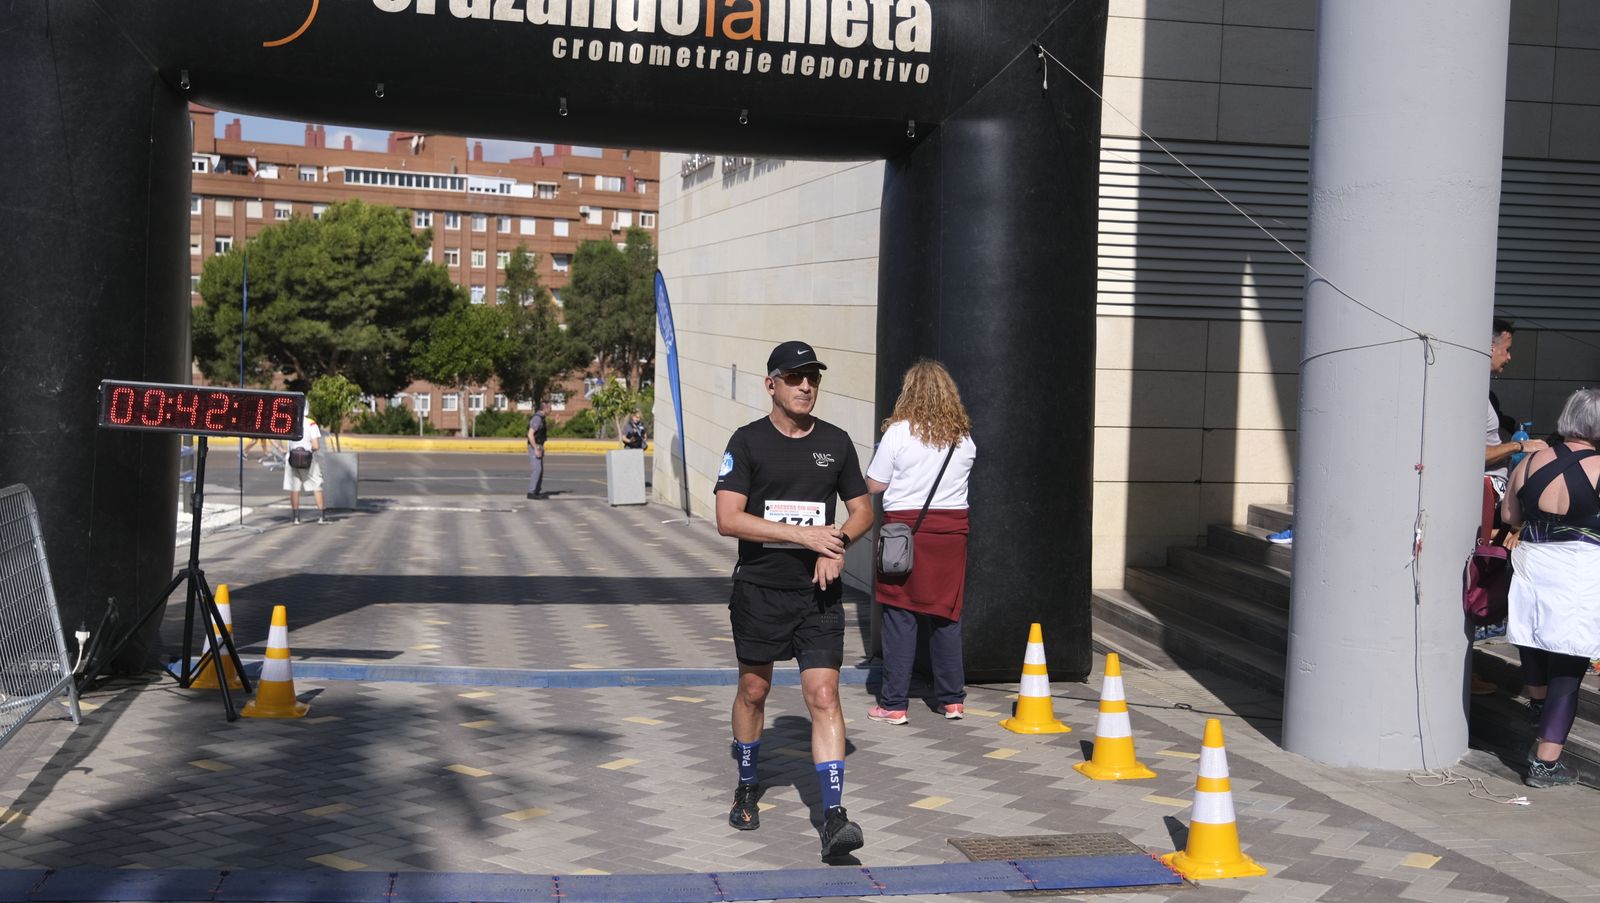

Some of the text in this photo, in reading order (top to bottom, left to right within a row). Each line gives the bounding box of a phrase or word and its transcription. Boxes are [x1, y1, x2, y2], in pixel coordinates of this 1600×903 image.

[552, 37, 931, 84] cronometraje deportivo
[742, 745, 752, 767] PAST
[828, 763, 841, 792] PAST
